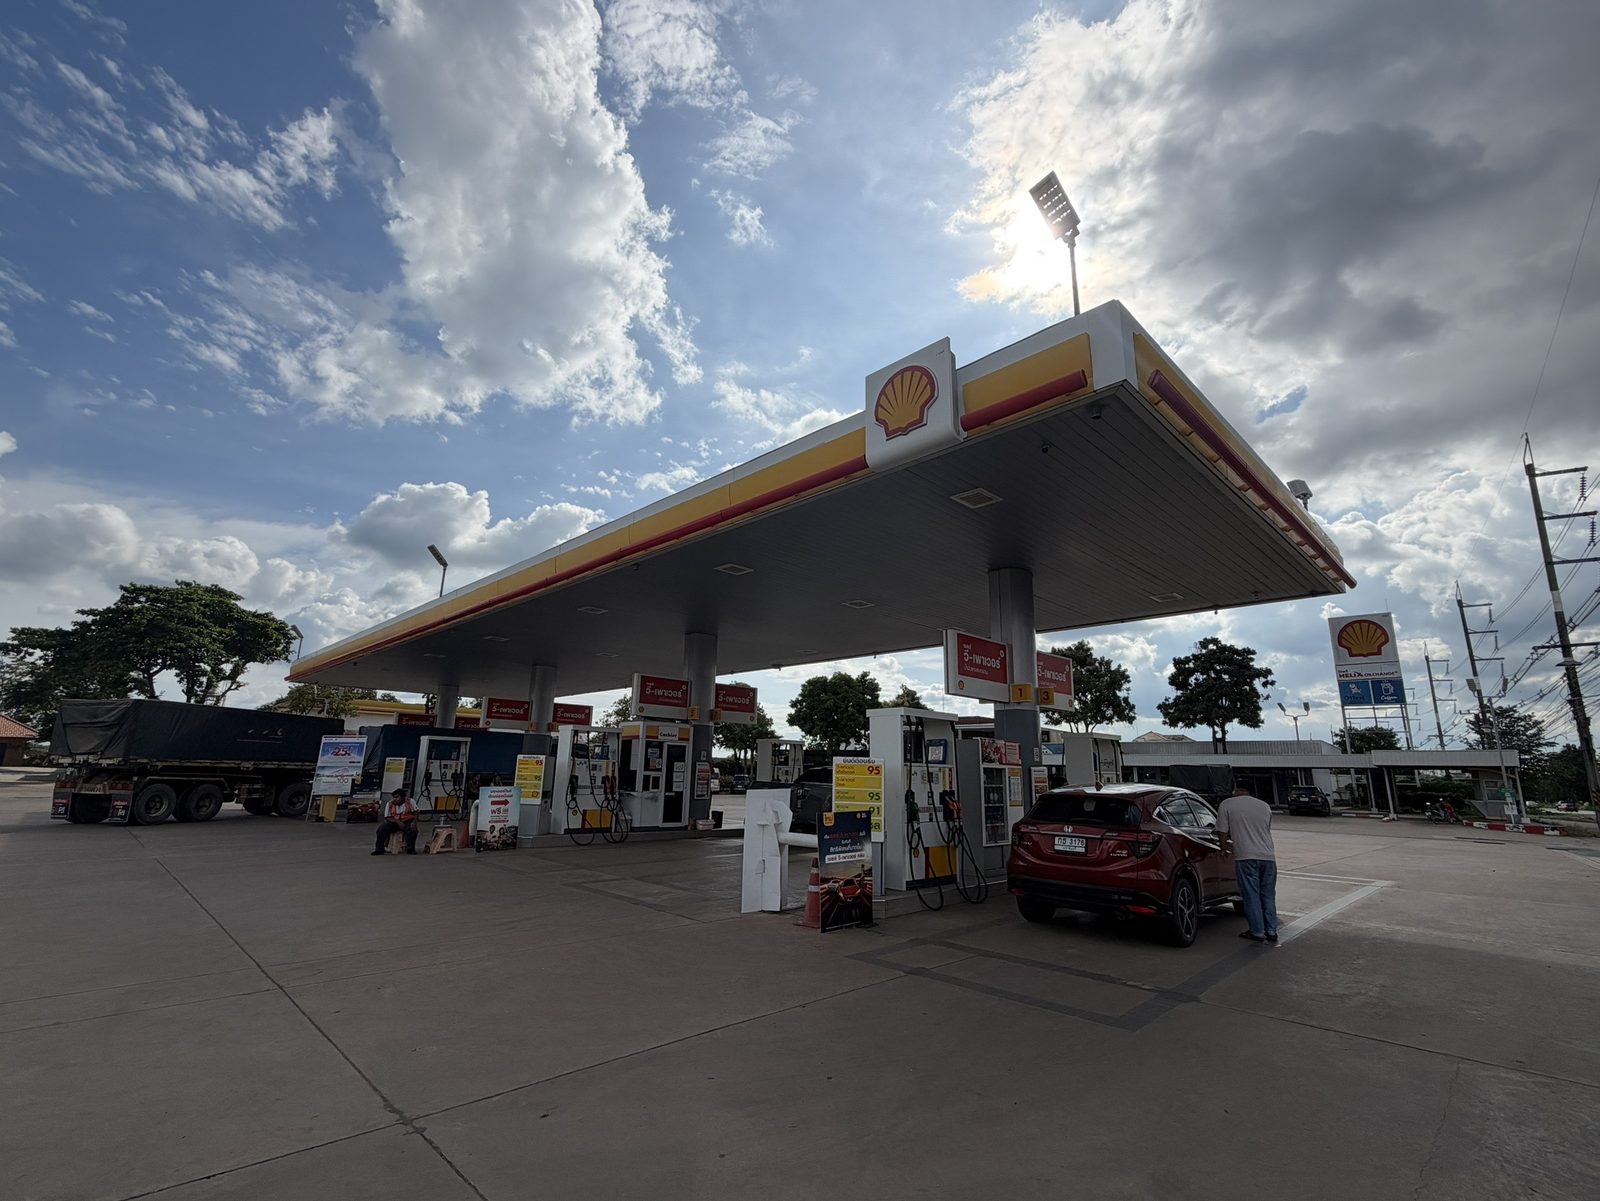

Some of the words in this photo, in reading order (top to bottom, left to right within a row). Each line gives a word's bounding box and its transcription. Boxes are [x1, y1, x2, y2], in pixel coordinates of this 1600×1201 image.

[963, 649, 1001, 669] วี-เพาเวอร์
[646, 685, 682, 699] วี-เพาเวอร์
[1018, 688, 1023, 698] 1
[1043, 691, 1050, 701] 3
[659, 730, 678, 738] Cashier
[867, 765, 881, 775] 95
[868, 792, 881, 801] 95
[869, 806, 880, 815] 91
[1069, 838, 1085, 847] 3176
